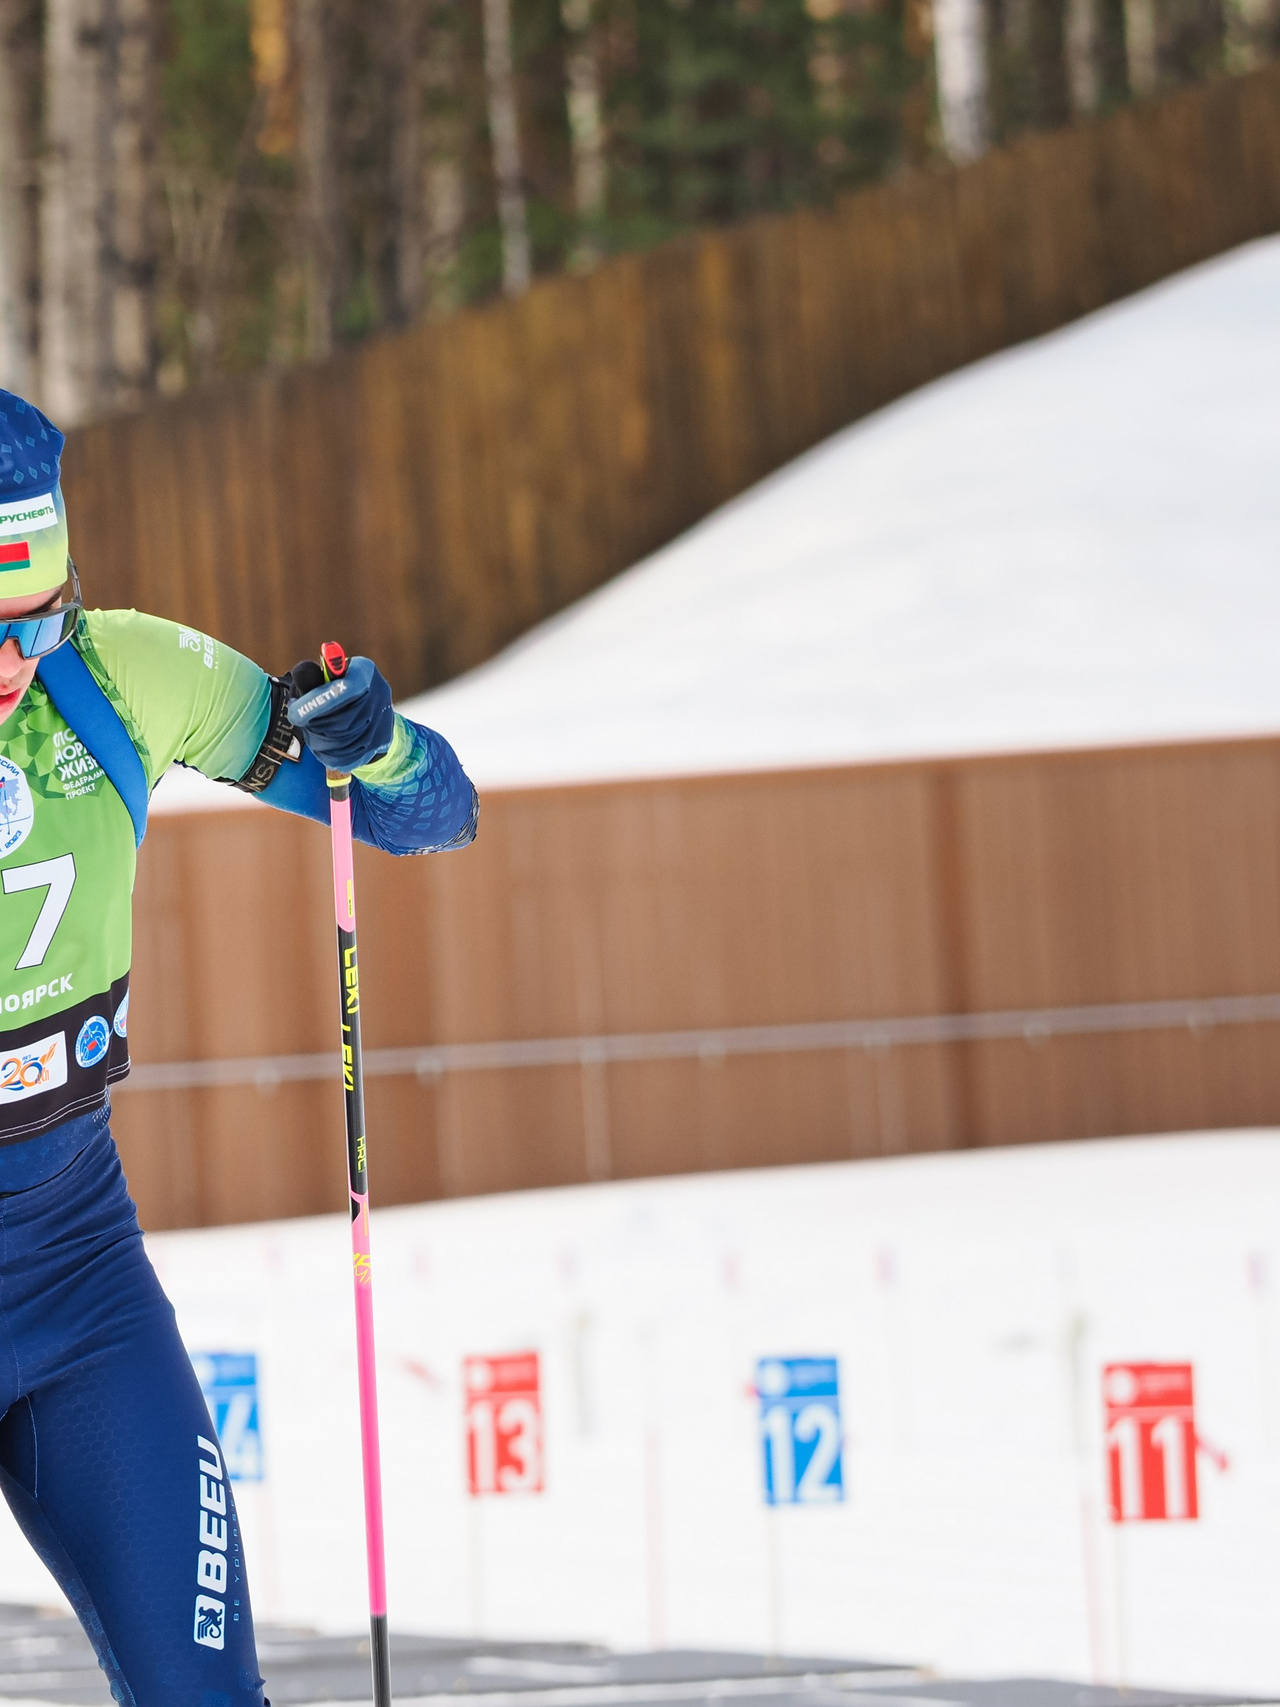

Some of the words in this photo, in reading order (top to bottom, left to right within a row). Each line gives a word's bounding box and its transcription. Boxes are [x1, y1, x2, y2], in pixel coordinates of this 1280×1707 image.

[65, 782, 96, 800] ПРОЕКТ
[344, 944, 360, 1015] LEKI
[468, 1398, 541, 1492] 13
[761, 1404, 843, 1502] 12
[1106, 1414, 1187, 1519] 11
[196, 1434, 228, 1594] BEEU
